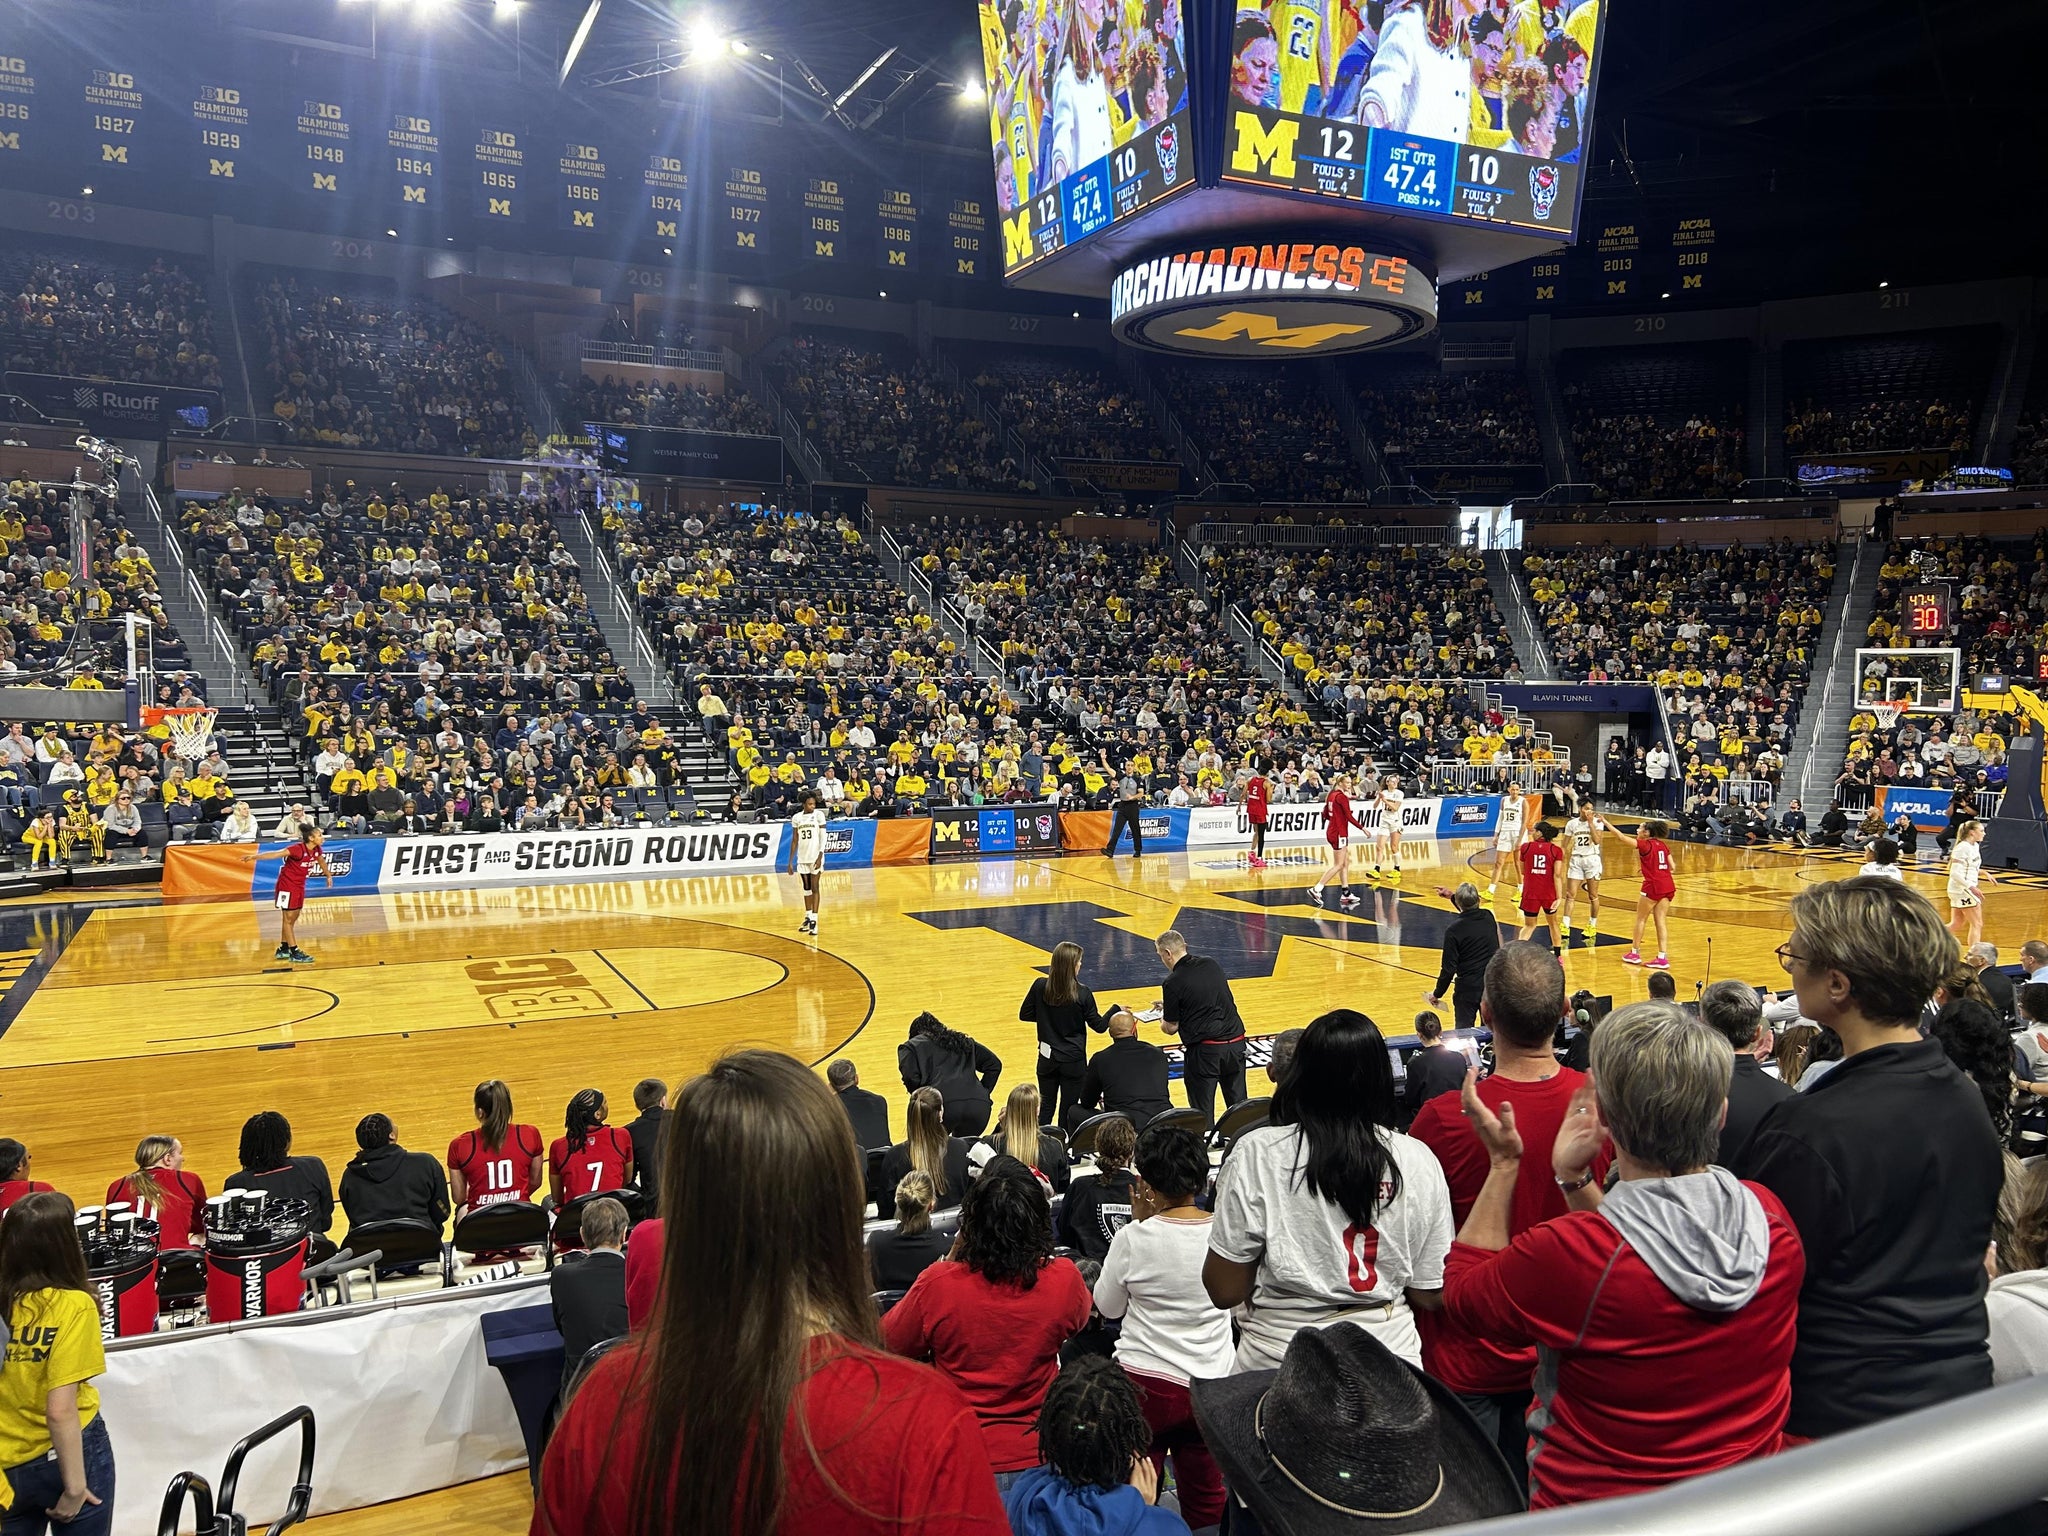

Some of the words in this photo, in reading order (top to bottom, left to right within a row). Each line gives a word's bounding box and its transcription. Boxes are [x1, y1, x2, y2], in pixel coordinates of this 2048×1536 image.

[85, 86, 142, 102] CHAMPIONS
[194, 101, 248, 117] CHAMPIONS
[95, 115, 135, 134] 1927
[297, 116, 350, 132] CHAMPIONS
[202, 130, 240, 149] 1929
[388, 130, 439, 146] CHAMPIONS
[1231, 111, 1300, 179] M
[1320, 127, 1354, 161] 12
[102, 144, 128, 163] M
[307, 144, 344, 163] 1948
[475, 144, 523, 160] CHAMPIONS
[1390, 147, 1409, 162] 1ST
[1413, 151, 1436, 166] QTR
[209, 158, 235, 178] M
[396, 157, 432, 176] 1964
[560, 158, 606, 172] CHAMPIONS
[1115, 147, 1136, 183] 10
[1312, 162, 1343, 179] FOULS
[1348, 169, 1356, 181] 3
[1468, 153, 1499, 186] 10
[312, 172, 337, 191] M
[482, 171, 516, 189] 1965
[644, 170, 688, 183] CHAMPIONS
[1384, 163, 1437, 195] 47.4
[567, 184, 599, 201] 1966
[725, 181, 767, 196] CHAMPIONS
[1137, 179, 1142, 192] 3
[1318, 178, 1337, 192] TOL
[1340, 182, 1348, 194] 4
[403, 185, 426, 204] M
[804, 192, 844, 206] CHAMPIONS
[1134, 194, 1139, 206] 4
[1397, 192, 1420, 206] POSS
[1462, 188, 1491, 203] FOULS
[1495, 193, 1502, 204] 3
[489, 198, 511, 216] M
[651, 196, 682, 212] 1974
[878, 203, 917, 216] CHAMPIONS
[1072, 189, 1102, 225] 47.4
[1467, 202, 1485, 215] TOL
[1487, 205, 1495, 217] 4
[48, 202, 96, 223] 203
[573, 210, 594, 228] M
[730, 206, 761, 223] 1977
[949, 212, 985, 226] CHAMPIONS
[656, 221, 677, 237] M
[812, 216, 840, 232] 1985
[1003, 207, 1034, 268] M
[1037, 194, 1057, 225] 12
[1603, 225, 1634, 238] NCAA
[1679, 218, 1711, 231] NCAA
[736, 231, 756, 248] M
[884, 226, 911, 242] 1986
[1598, 238, 1619, 247] FINAL
[1620, 236, 1639, 245] FOUR
[1672, 231, 1694, 240] FINAL
[1696, 230, 1715, 239] FOUR
[331, 240, 373, 259] 204
[815, 240, 834, 256] M
[953, 236, 979, 251] 2012
[888, 250, 906, 266] M
[1603, 258, 1632, 272] 2013
[1678, 252, 1708, 266] 2018
[957, 259, 974, 275] M
[1532, 264, 1560, 277] 1989
[628, 270, 663, 287] 205
[1682, 274, 1702, 289] M
[1536, 286, 1554, 300] M
[1607, 280, 1626, 294] M
[803, 296, 835, 313] 206
[1465, 290, 1483, 304] M
[1880, 293, 1909, 309] 211
[1008, 317, 1041, 332] 207
[1634, 318, 1666, 332] 210
[103, 391, 160, 411] Ruoff
[103, 409, 160, 422] MORTGAGE
[653, 449, 678, 458] WEISER
[679, 450, 702, 459] FAMILY
[703, 452, 719, 460] CLUB
[1065, 464, 1119, 475] UNIVERSITY
[1120, 466, 1132, 475] OF
[1134, 467, 1177, 477] MICHIGAN
[1909, 594, 1935, 606] 47.4
[1912, 607, 1939, 631] 30
[1532, 694, 1560, 702] BLAVIN
[1562, 694, 1593, 702] TUNNEL
[1459, 805, 1479, 813] MARCH
[1460, 812, 1487, 821] MADNESS
[1505, 812, 1515, 821] 15
[935, 821, 961, 842] M
[964, 820, 979, 832] 12
[988, 827, 1006, 836] 47.4
[1015, 818, 1030, 829] 10
[1199, 821, 1223, 829] HOSTED
[801, 829, 812, 840] 33
[1577, 836, 1590, 847] 22
[393, 842, 486, 877] FIRST
[484, 850, 511, 864] AND
[515, 836, 633, 871] SECOND
[643, 831, 771, 865] ROUNDS
[1533, 854, 1546, 868] 12
[1658, 850, 1665, 864] 0
[486, 1159, 513, 1190] 10
[586, 1161, 604, 1192] 7
[476, 1189, 521, 1205] JERNIGAN
[1342, 1224, 1380, 1293] 0
